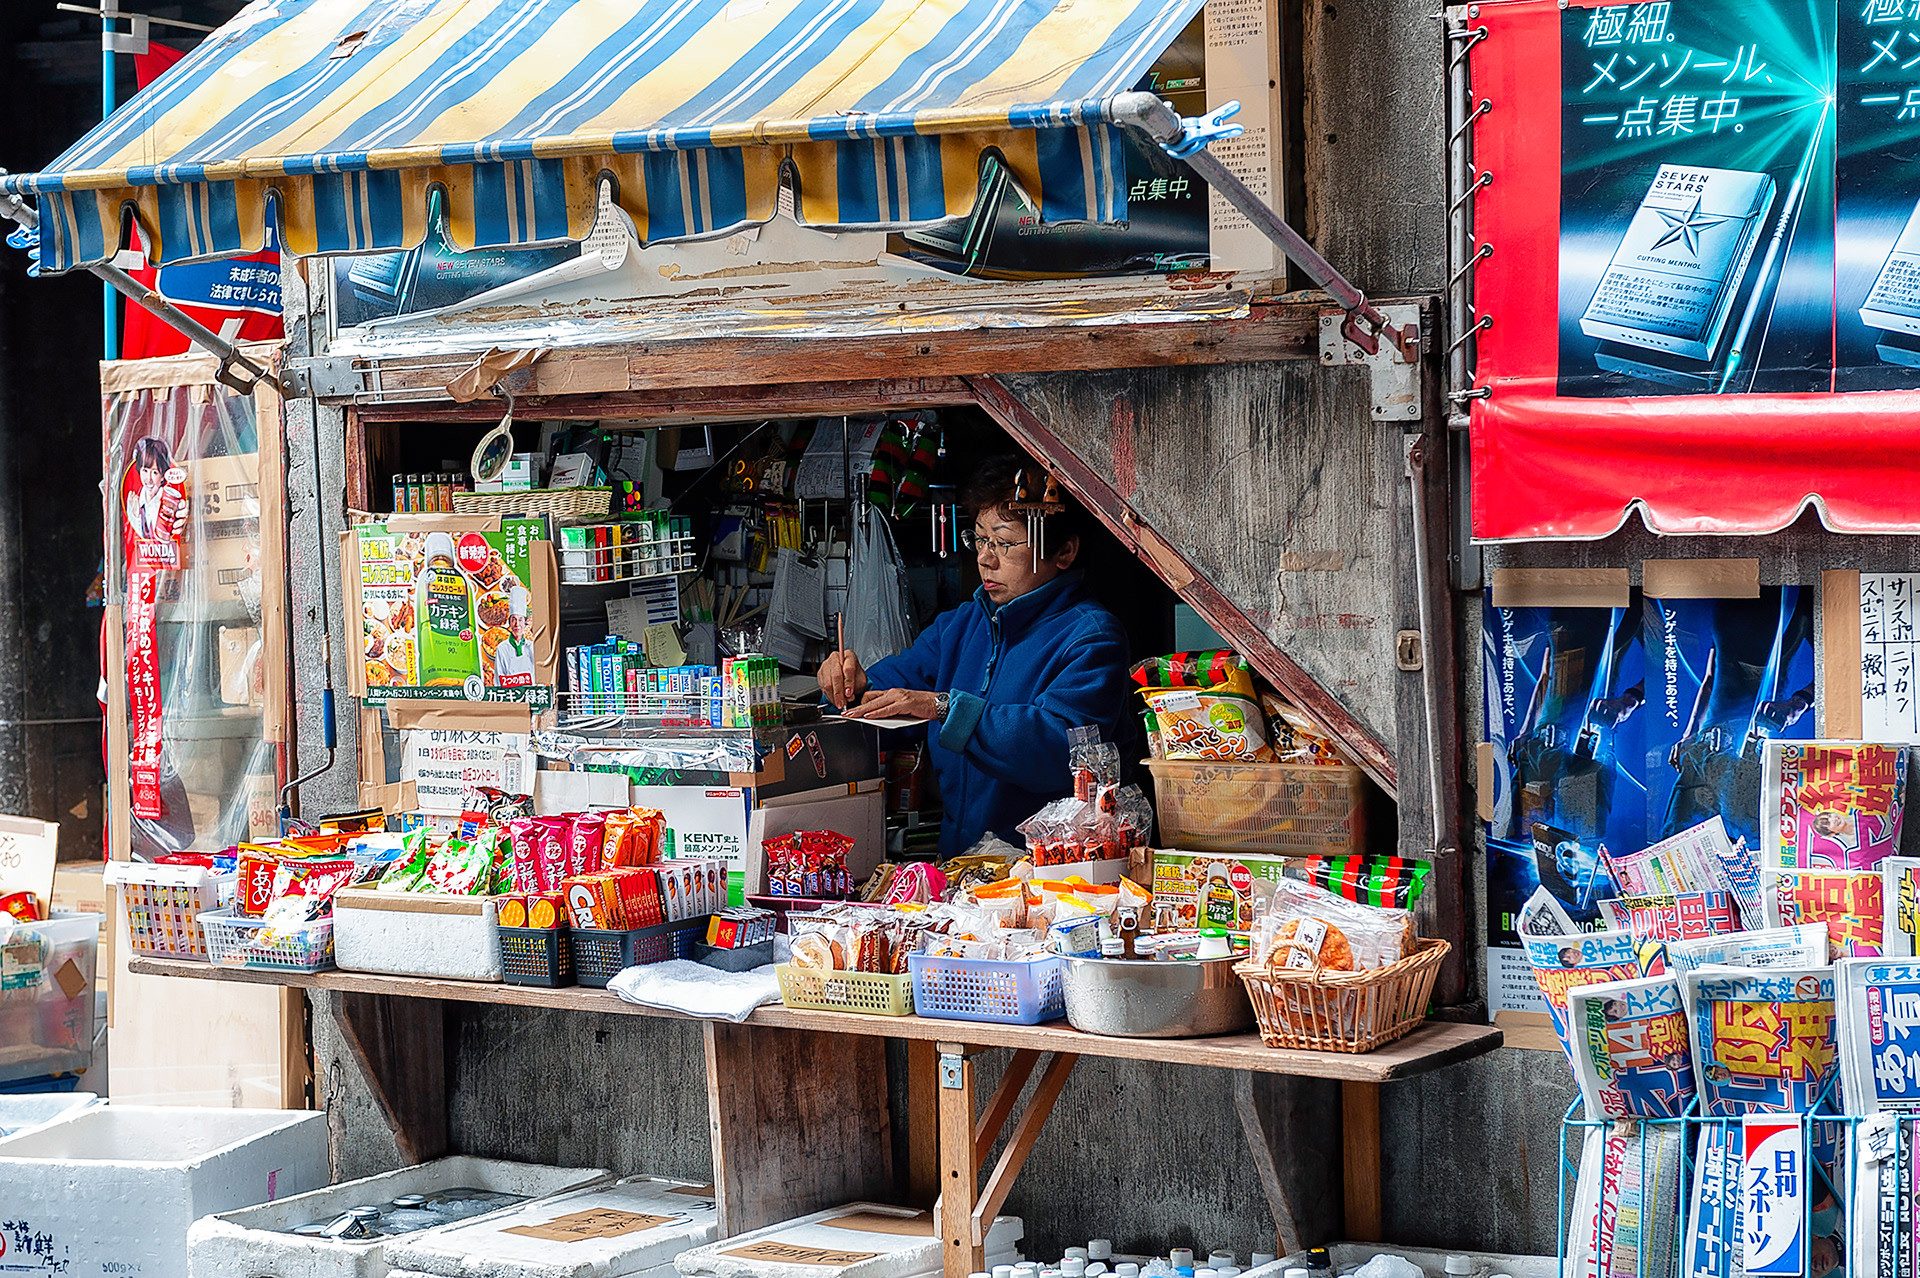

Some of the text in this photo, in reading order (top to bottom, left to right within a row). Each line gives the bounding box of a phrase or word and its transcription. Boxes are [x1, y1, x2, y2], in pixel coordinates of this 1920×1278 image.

[1583, 2, 1675, 48] 極細。
[1583, 44, 1774, 93] メンソール、
[1583, 91, 1744, 138] 一点集中。
[1128, 175, 1192, 202] 点集中。
[1655, 180, 1704, 193] STARS
[1660, 171, 1709, 184] SEVEN
[1637, 255, 1702, 270] CUTTING MENTHOL
[138, 544, 175, 558] WONDA
[361, 540, 393, 560] 体脂肪、
[459, 546, 487, 560] 新発売
[506, 525, 516, 568] ご一緒に。
[517, 525, 527, 557] 食事と
[361, 564, 411, 584] コレステロール
[364, 589, 406, 600] が気になる方に。
[430, 603, 468, 619] カテキン
[1860, 580, 1883, 641] スポニチ
[1888, 578, 1913, 641] サンスポ
[439, 618, 460, 631] 緑茶
[140, 572, 158, 769] スッと飲めて、キリッと苦味。
[1502, 608, 1516, 724] シゲキを持ちあそべ。
[1664, 609, 1679, 728] シゲキを持ちあそべ。
[1862, 652, 1887, 700] 報知
[1890, 650, 1910, 713] ニッカン
[487, 689, 549, 705] カテキン緑茶
[1799, 744, 1897, 815] 結婚
[1780, 760, 1798, 839] サンスポ
[684, 845, 740, 854] 最高メンソール
[1155, 881, 1197, 893] コレステロール
[1156, 865, 1183, 878] 体脂肪、
[1231, 872, 1252, 883] 新発売
[1585, 998, 1612, 1080] スポーツ報知
[1608, 1021, 1652, 1067] 14
[1714, 1001, 1835, 1078] 阪神
[1748, 1150, 1797, 1256] 日刊 スポーツ
